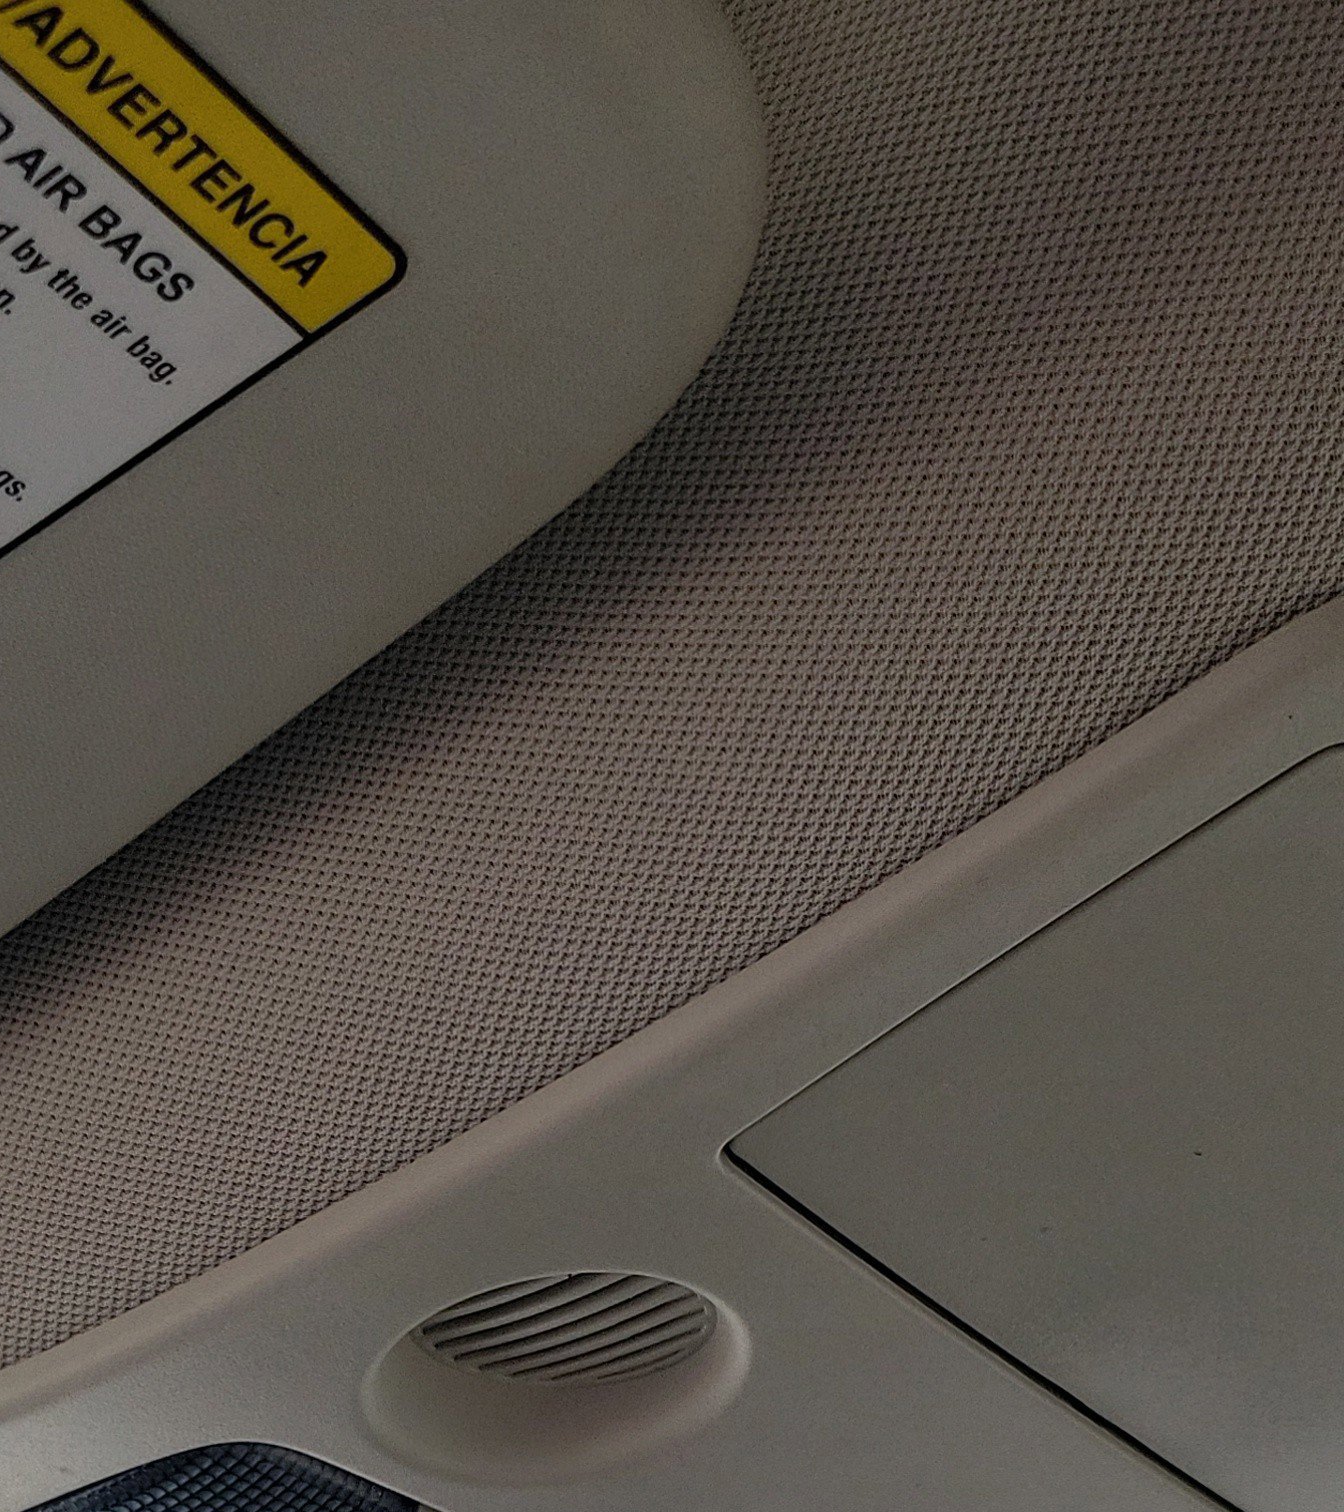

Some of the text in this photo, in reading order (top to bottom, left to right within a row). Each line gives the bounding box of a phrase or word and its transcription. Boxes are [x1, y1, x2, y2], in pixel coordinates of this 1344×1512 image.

[2, 146, 87, 213] AIR
[77, 203, 195, 302] BAGS
[9, 236, 51, 274] by
[46, 267, 93, 310] the
[89, 308, 132, 339] air
[125, 334, 177, 385] bag.
